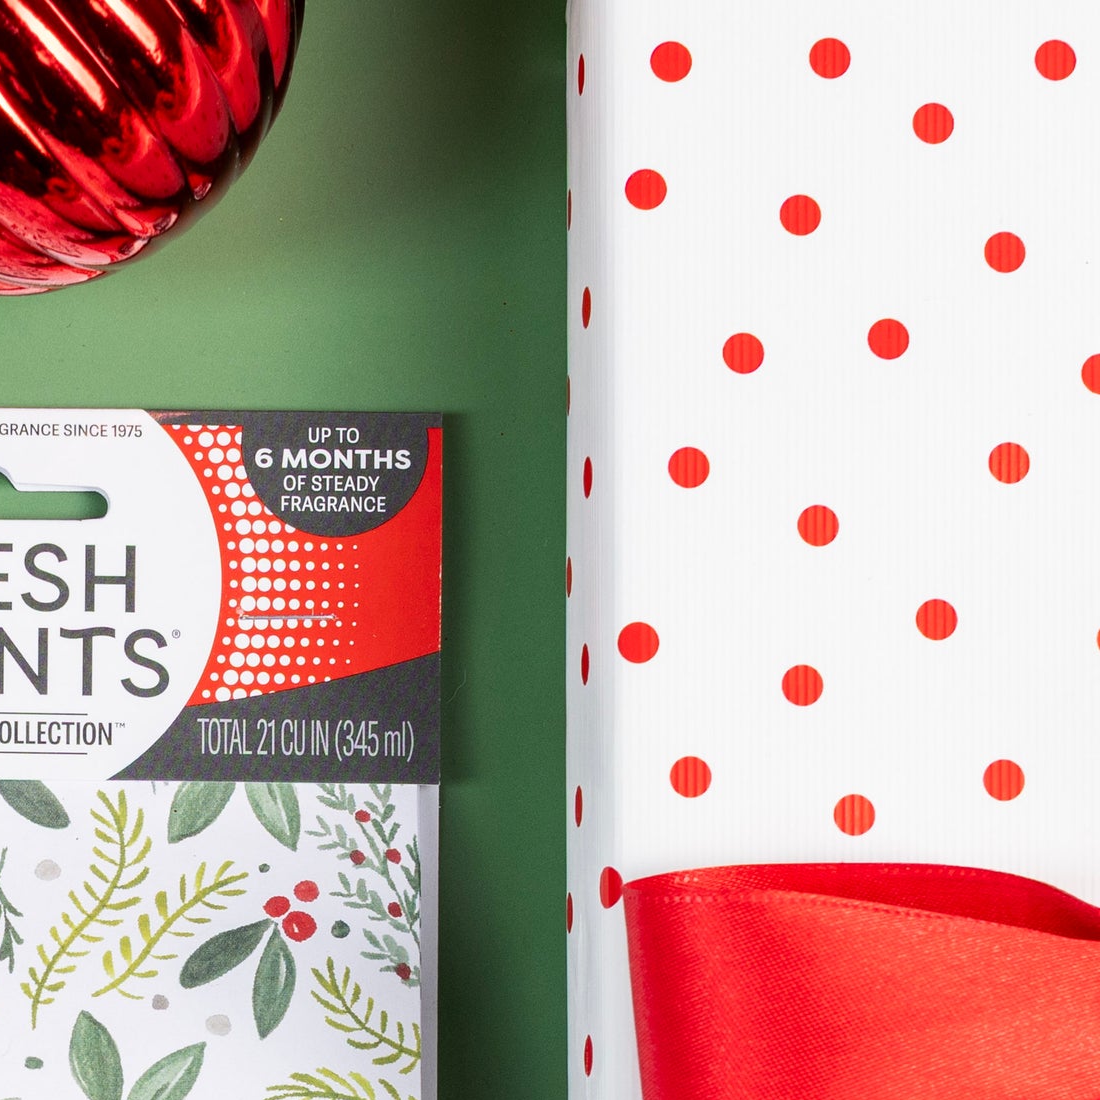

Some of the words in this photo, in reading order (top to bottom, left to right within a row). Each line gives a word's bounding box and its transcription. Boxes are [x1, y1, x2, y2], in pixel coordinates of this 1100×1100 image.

[63, 421, 107, 438] SINCE
[111, 422, 143, 438] 1975
[307, 426, 331, 444] UP
[334, 426, 360, 444] TO
[254, 447, 273, 469] 6
[281, 447, 412, 470] MONTHS
[283, 474, 306, 492] OF
[311, 475, 380, 492] STEADY
[280, 495, 387, 513] FRAGRANCE
[197, 717, 253, 756] TOTAL
[256, 718, 277, 756] 21
[280, 719, 307, 756] CU
[310, 719, 330, 757] IN
[334, 719, 380, 762] (345
[383, 720, 415, 762] ml)
